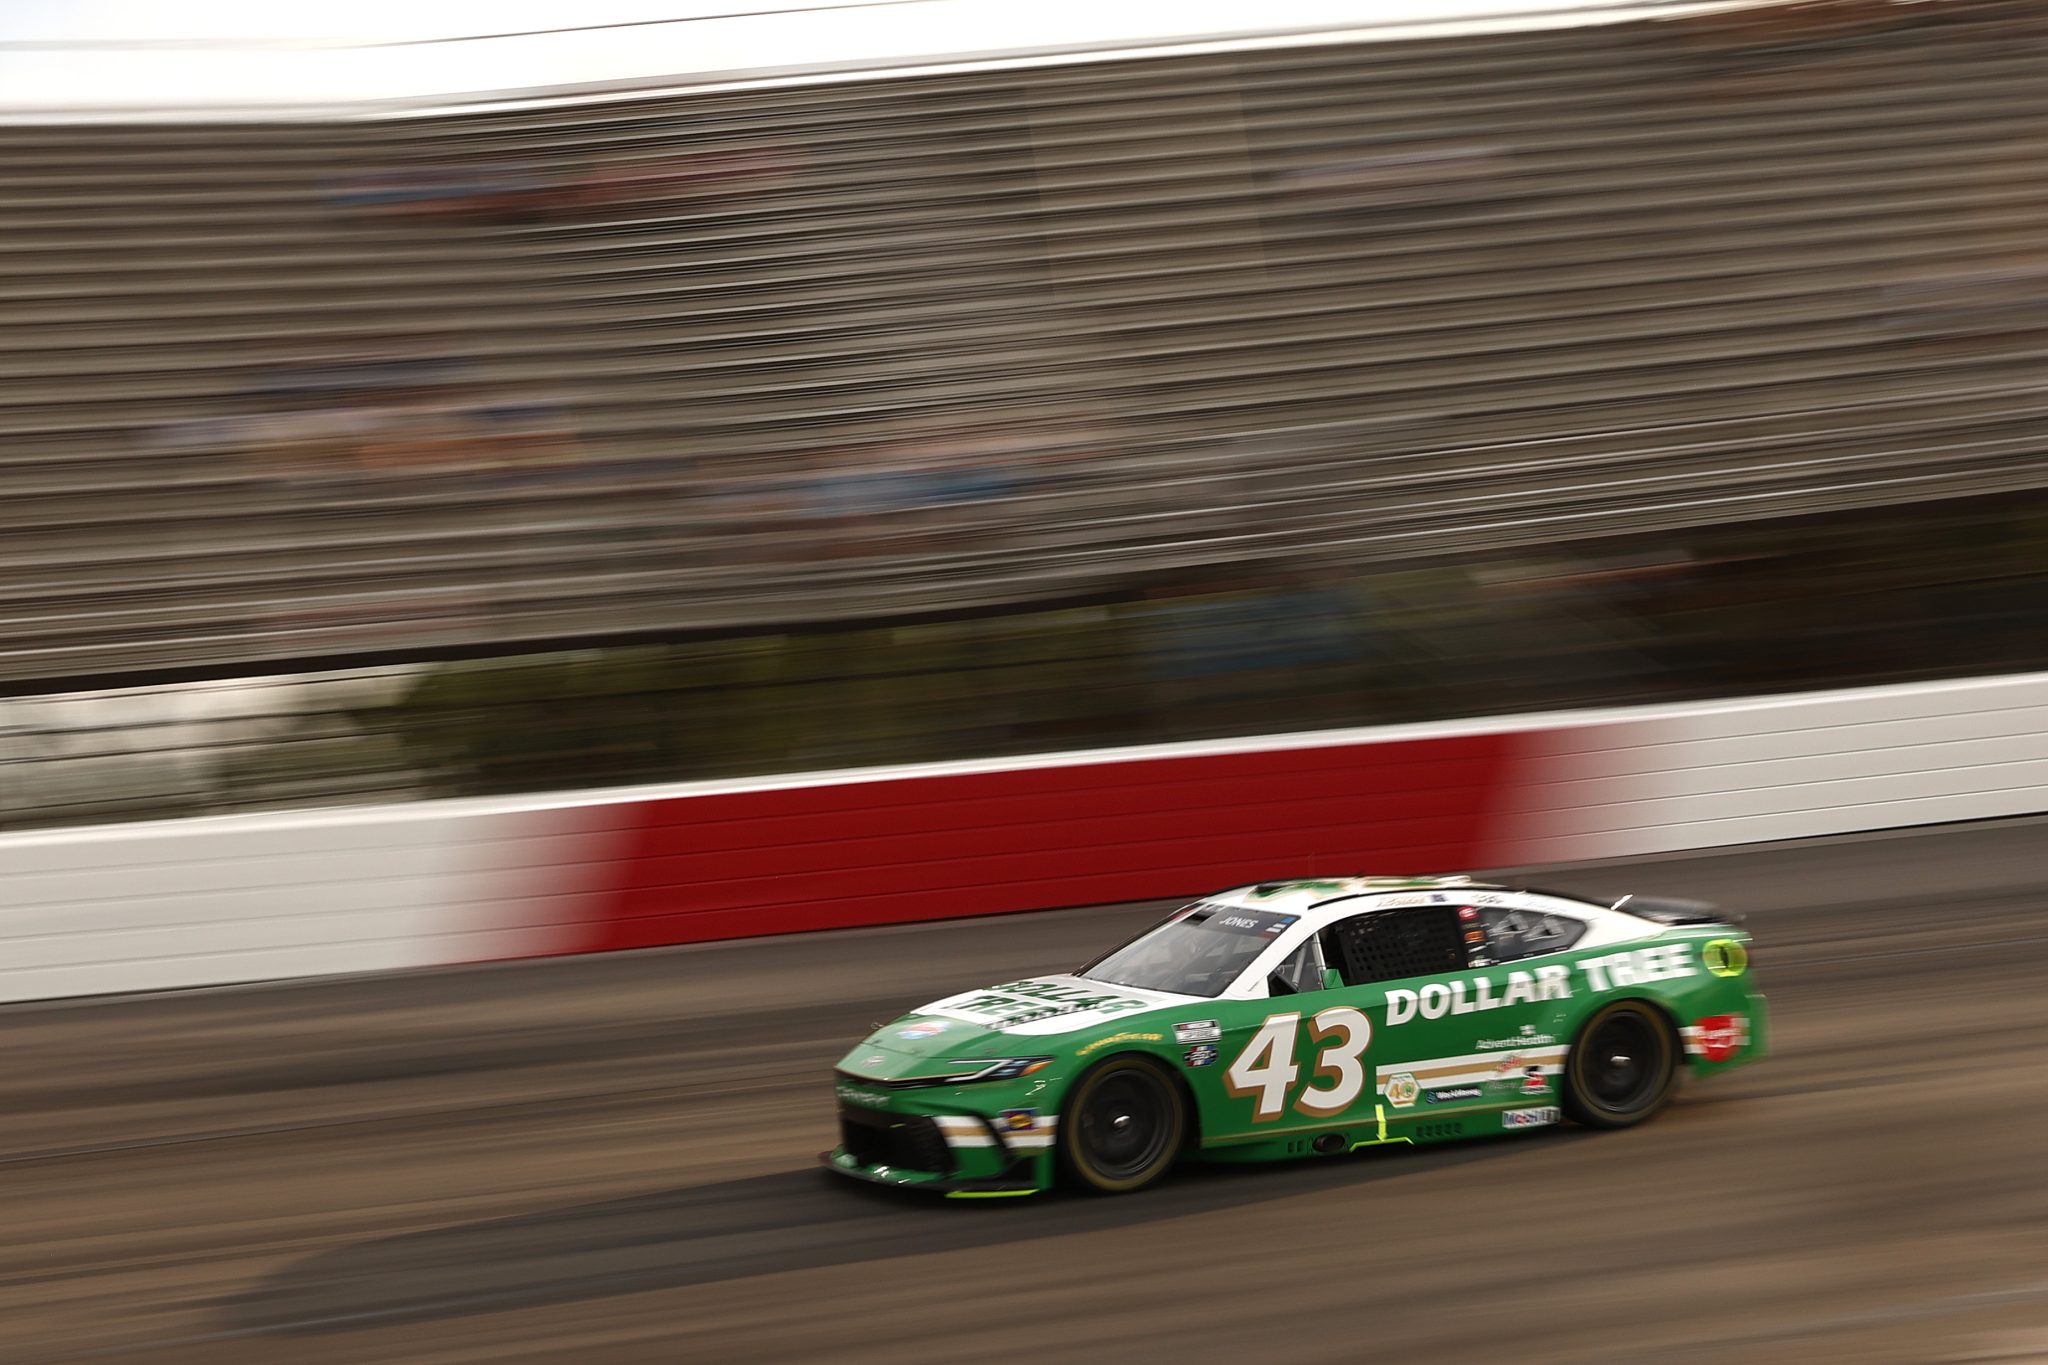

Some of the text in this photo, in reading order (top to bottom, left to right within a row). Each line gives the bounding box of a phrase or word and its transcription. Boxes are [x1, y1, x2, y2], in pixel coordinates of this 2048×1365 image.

[1219, 917, 1258, 928] JONES
[1385, 943, 1698, 1027] DOLLAR TREE
[1223, 1006, 1373, 1122] 43
